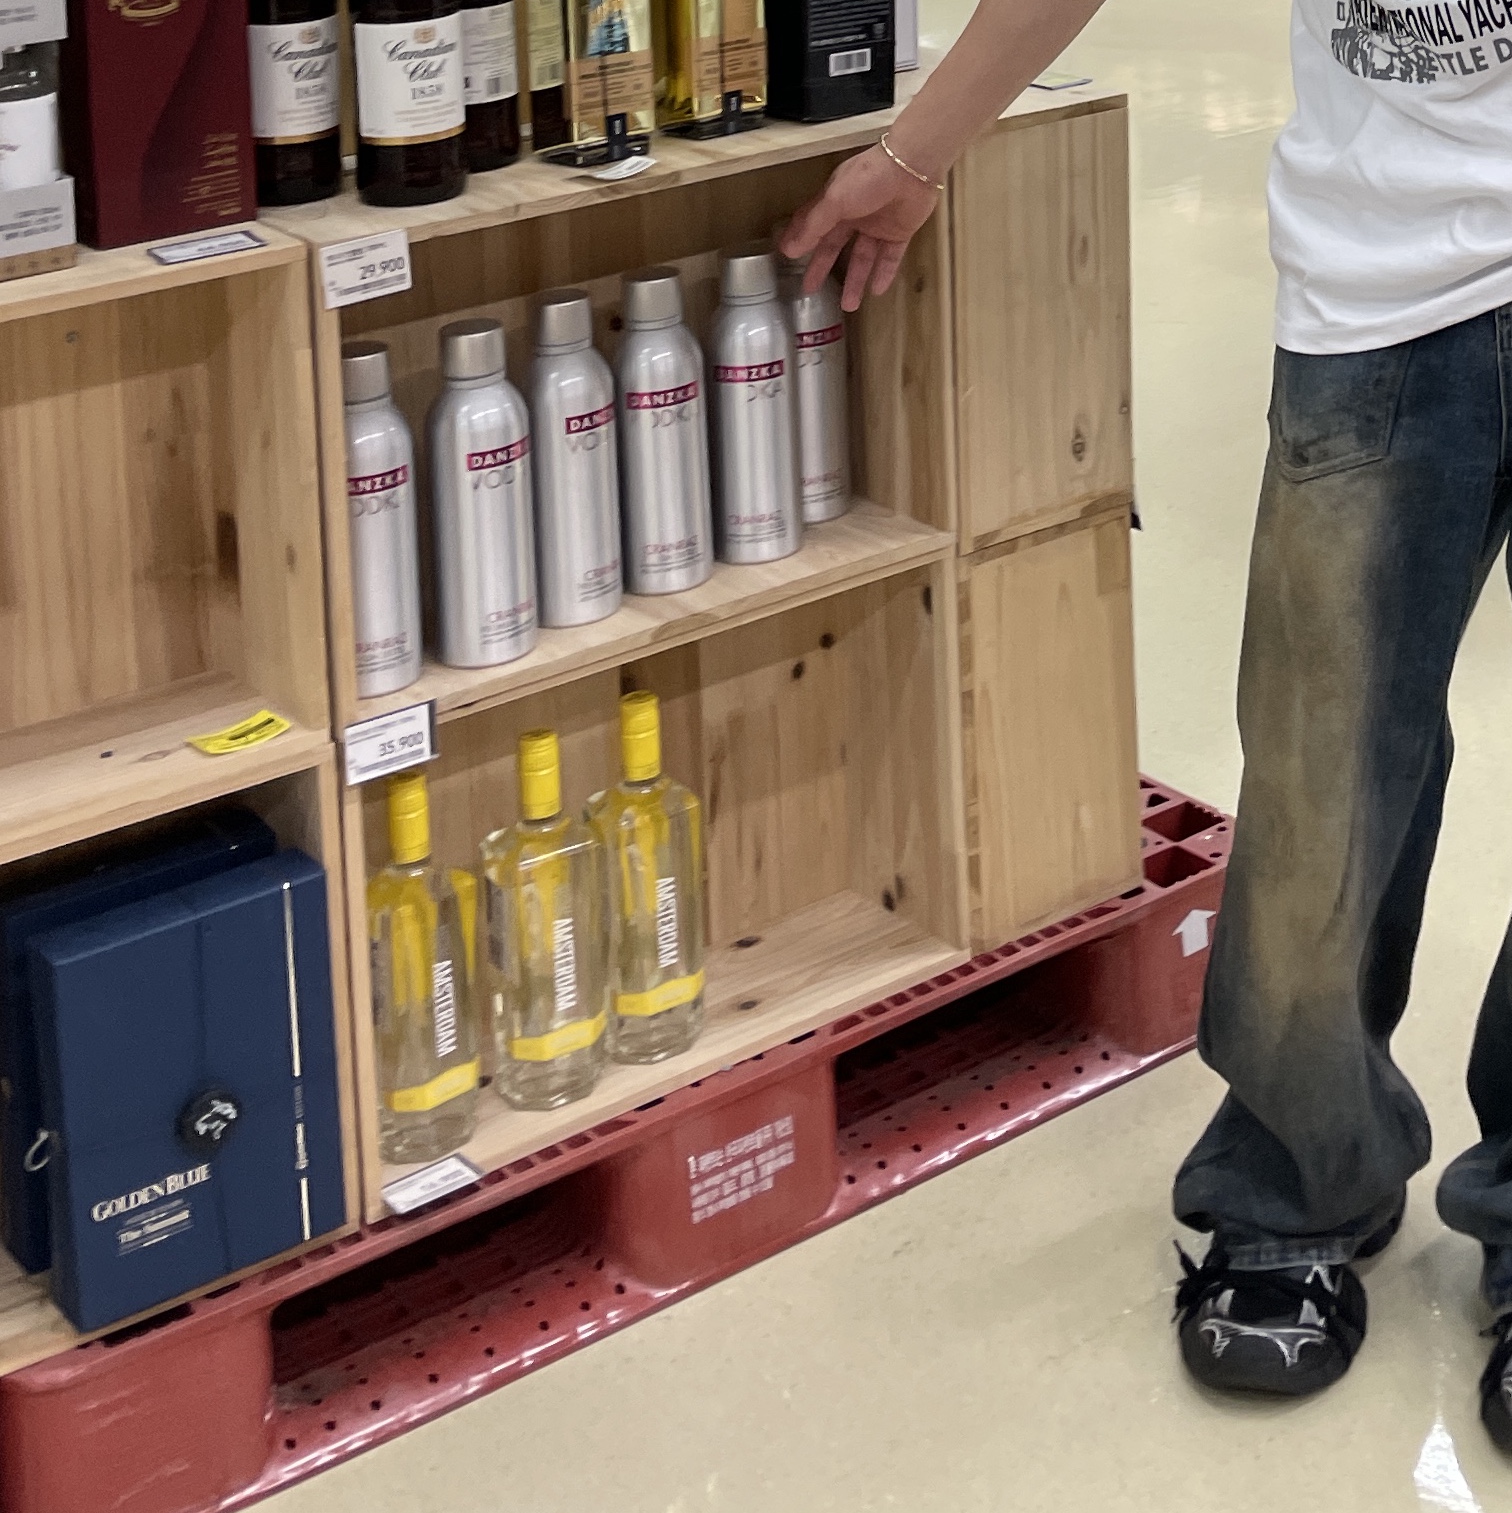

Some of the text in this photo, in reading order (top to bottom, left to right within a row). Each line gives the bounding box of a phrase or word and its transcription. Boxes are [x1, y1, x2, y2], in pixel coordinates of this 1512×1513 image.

[553, 917, 578, 1013] AMSTERDAM
[654, 876, 679, 969] AMSTERDAM
[432, 959, 457, 1058] AMSTERDAM
[91, 1162, 212, 1223] GOLDEN BLUE
